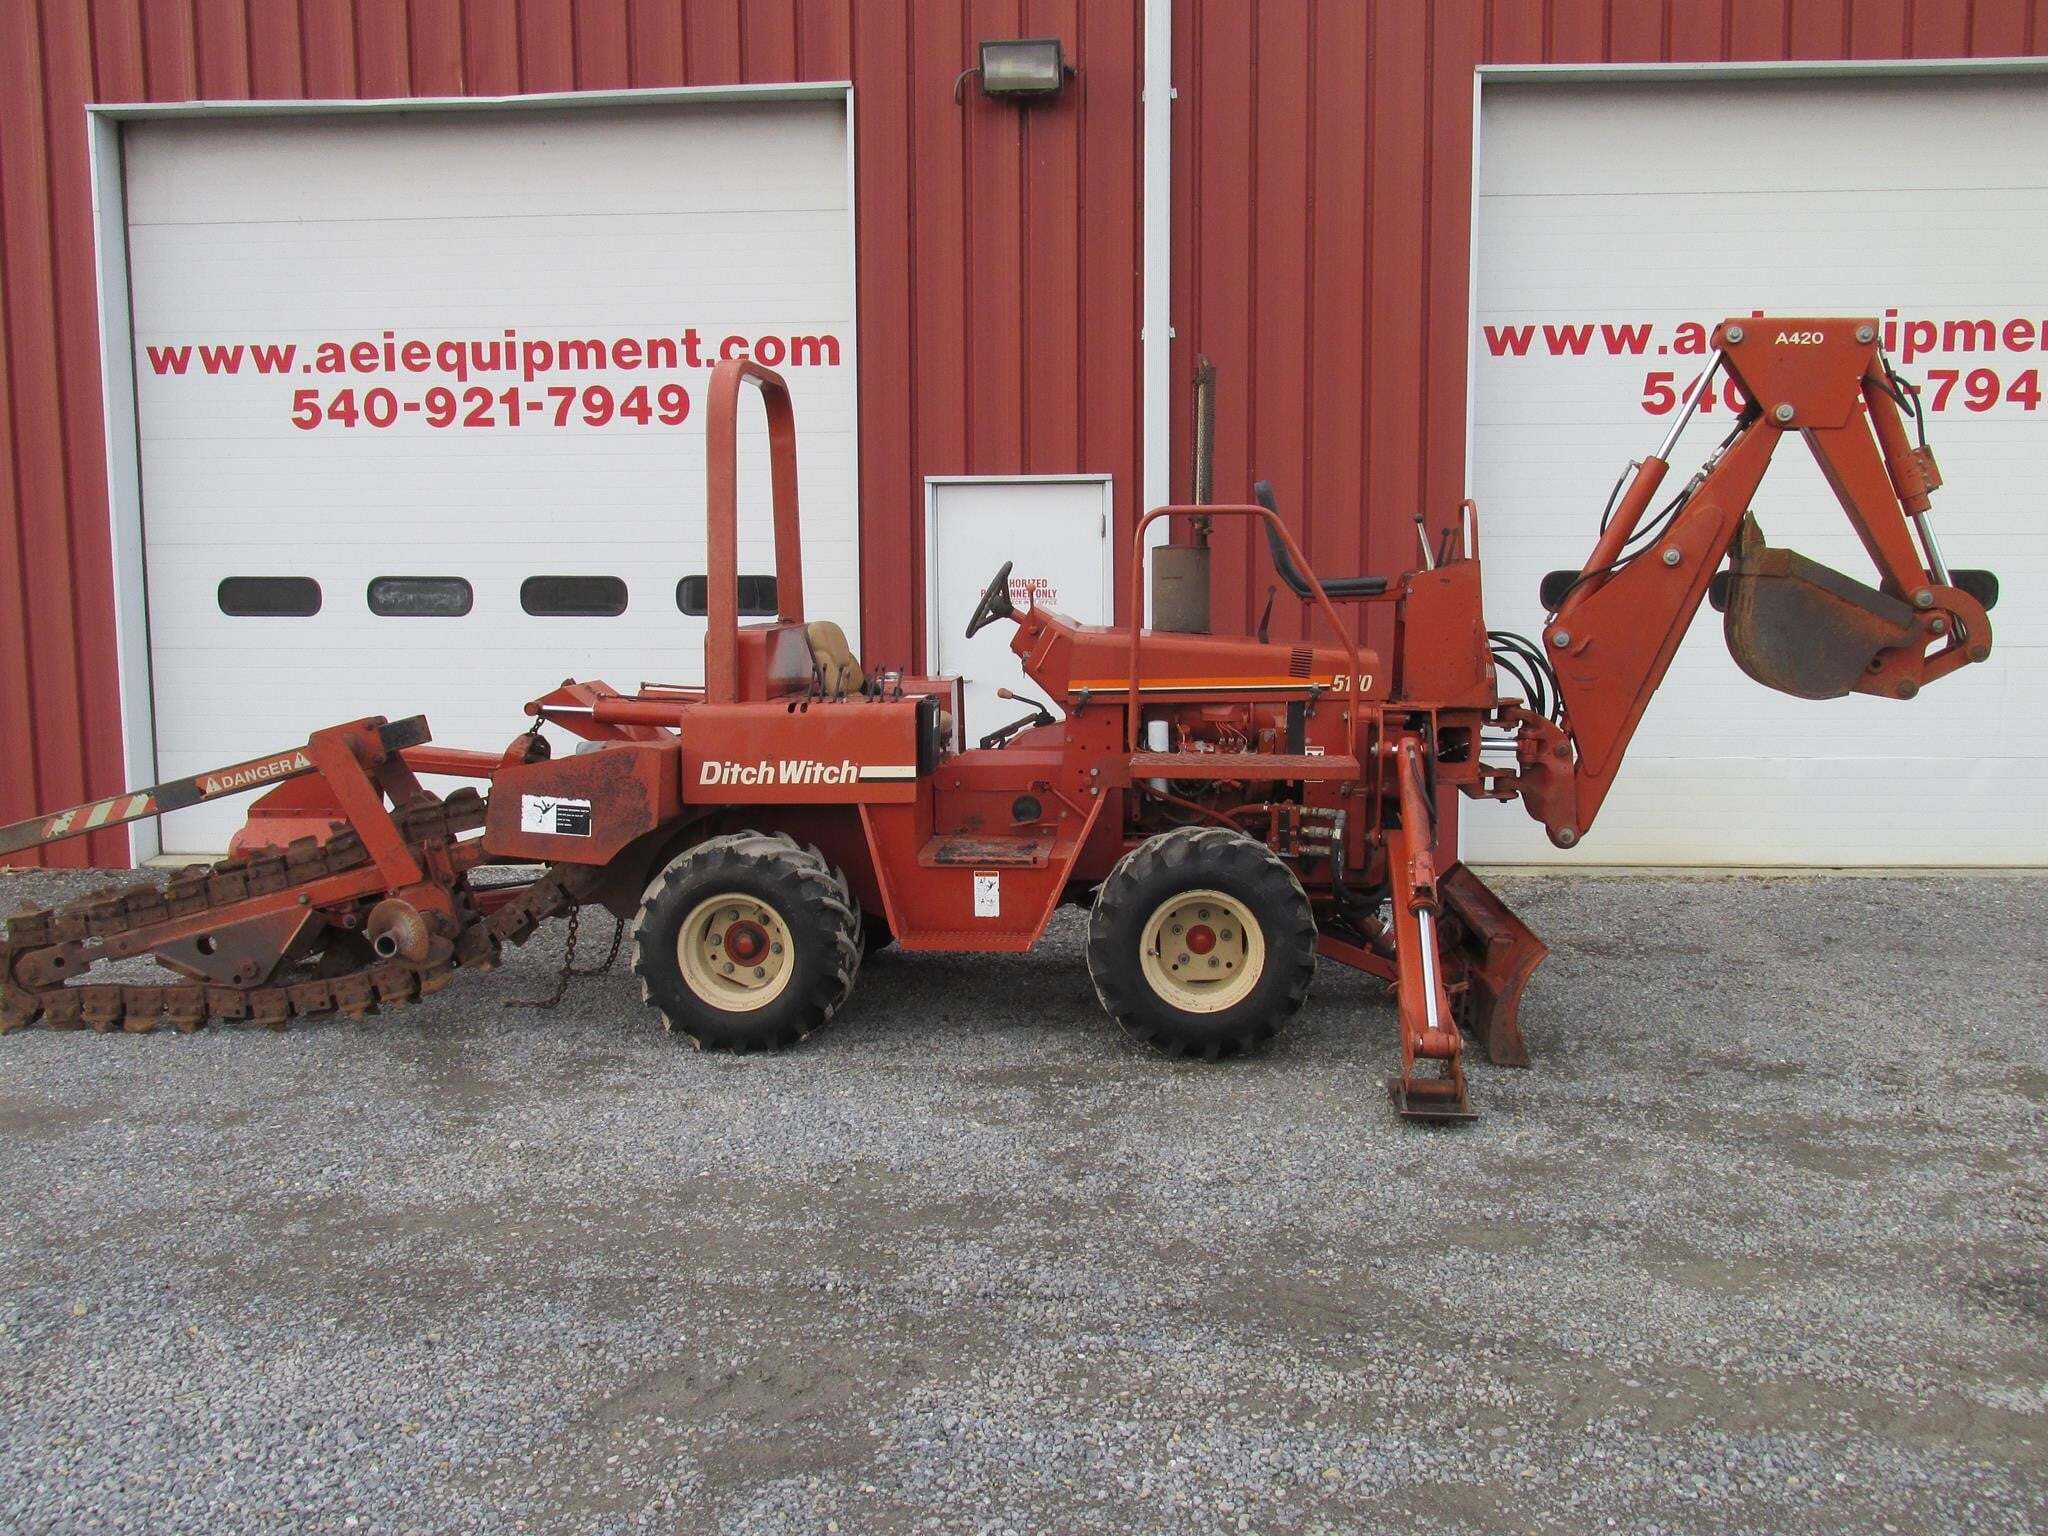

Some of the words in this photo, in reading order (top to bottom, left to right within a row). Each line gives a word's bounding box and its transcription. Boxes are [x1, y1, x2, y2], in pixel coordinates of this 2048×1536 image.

[1483, 309, 2048, 364] www.aipme
[1775, 331, 1824, 345] A420
[147, 329, 840, 382] www.aeiequipment.com
[291, 383, 690, 430] 540-921-7949
[1036, 588, 1057, 598] ONLY
[1332, 674, 1373, 692] 510
[221, 759, 292, 789] DANGER
[699, 760, 775, 785] Ditch
[779, 759, 857, 785] Witch
